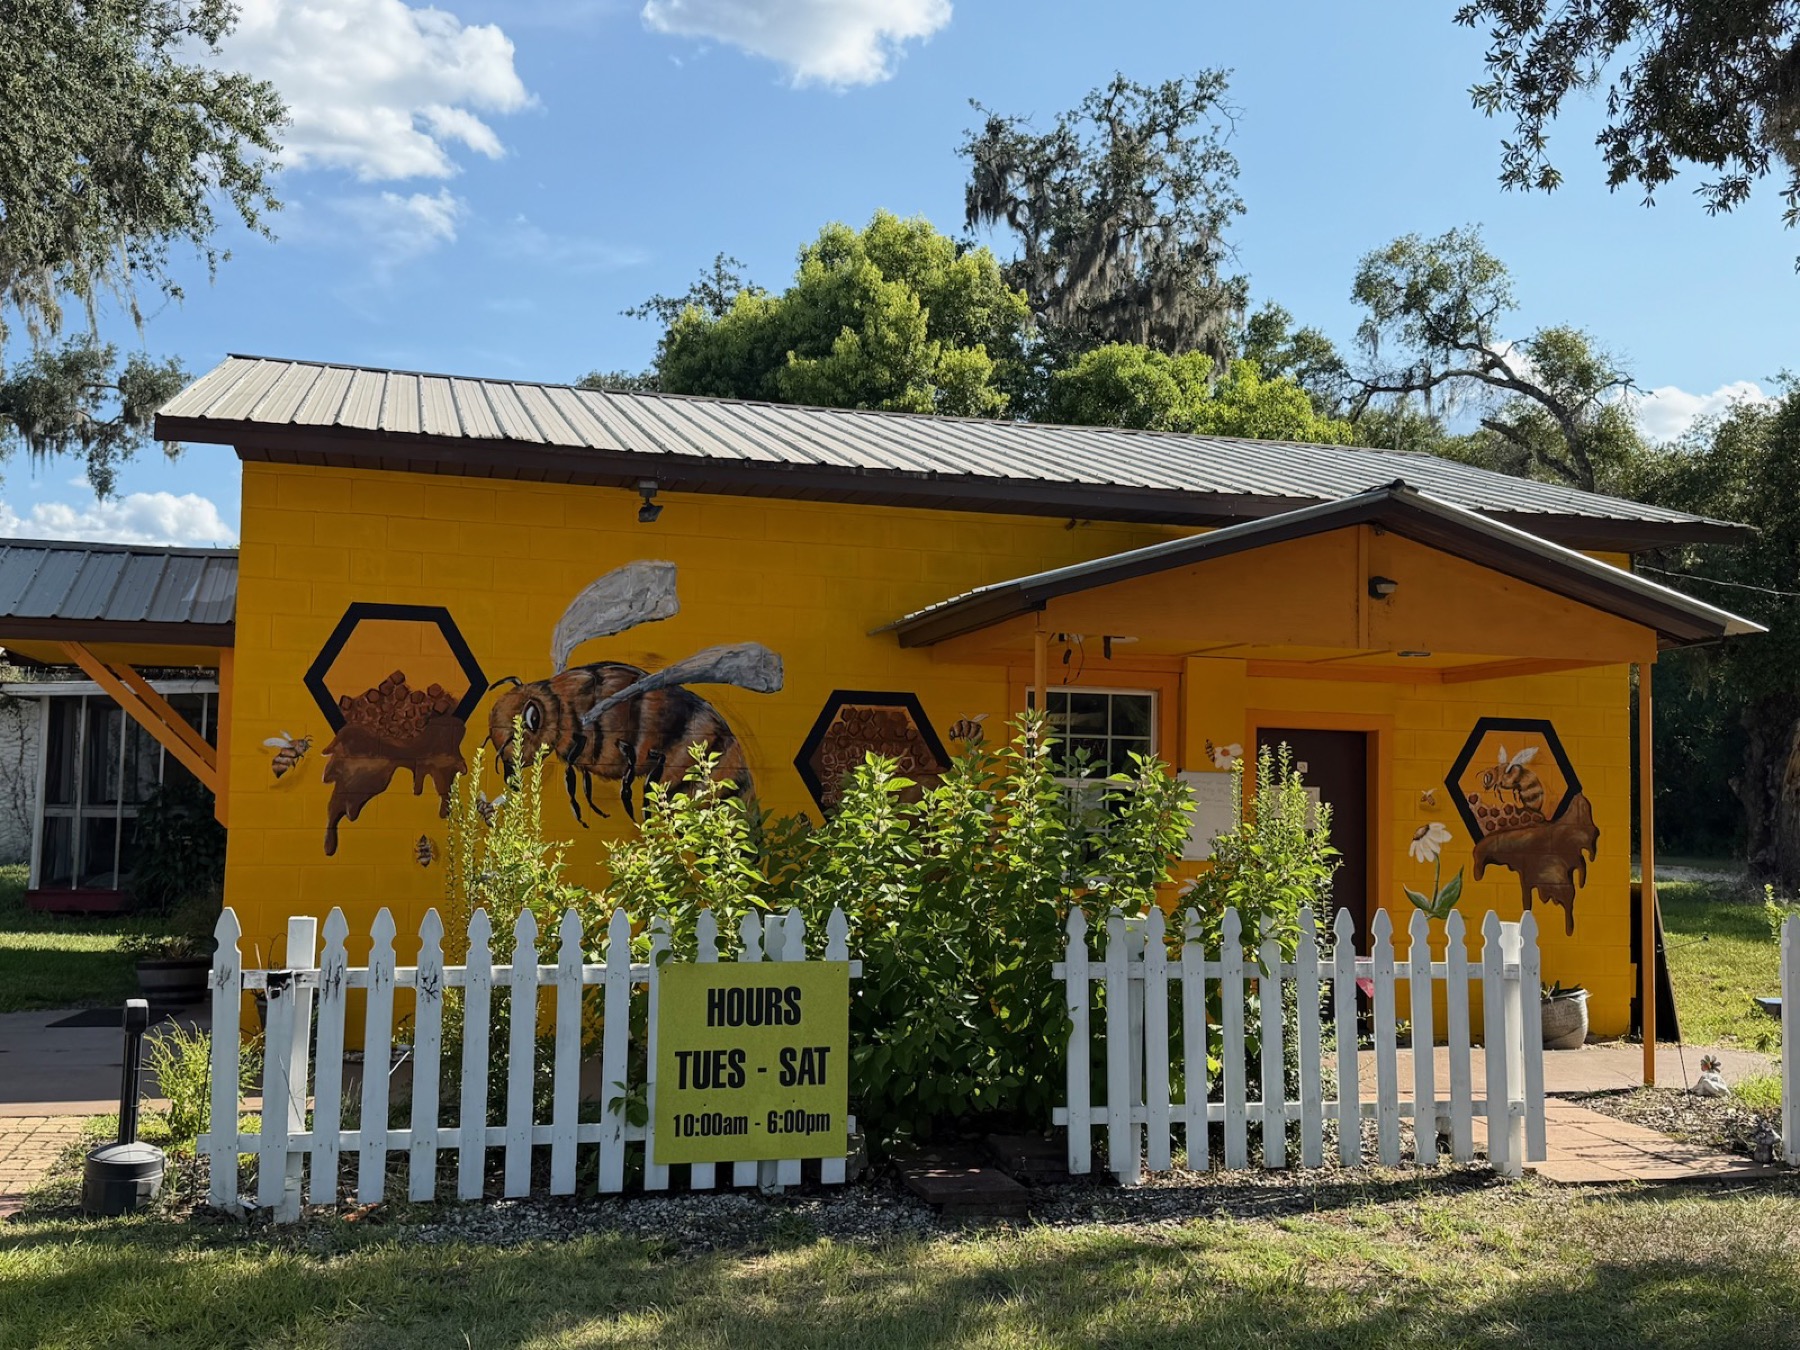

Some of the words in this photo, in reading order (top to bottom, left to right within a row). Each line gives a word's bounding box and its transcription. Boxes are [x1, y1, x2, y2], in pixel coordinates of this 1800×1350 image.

[707, 986, 802, 1027] HOURS
[674, 1048, 746, 1090] TUES
[779, 1046, 831, 1087] SAT
[673, 1112, 749, 1138] 10:00am
[767, 1109, 831, 1136] 6:00pm
